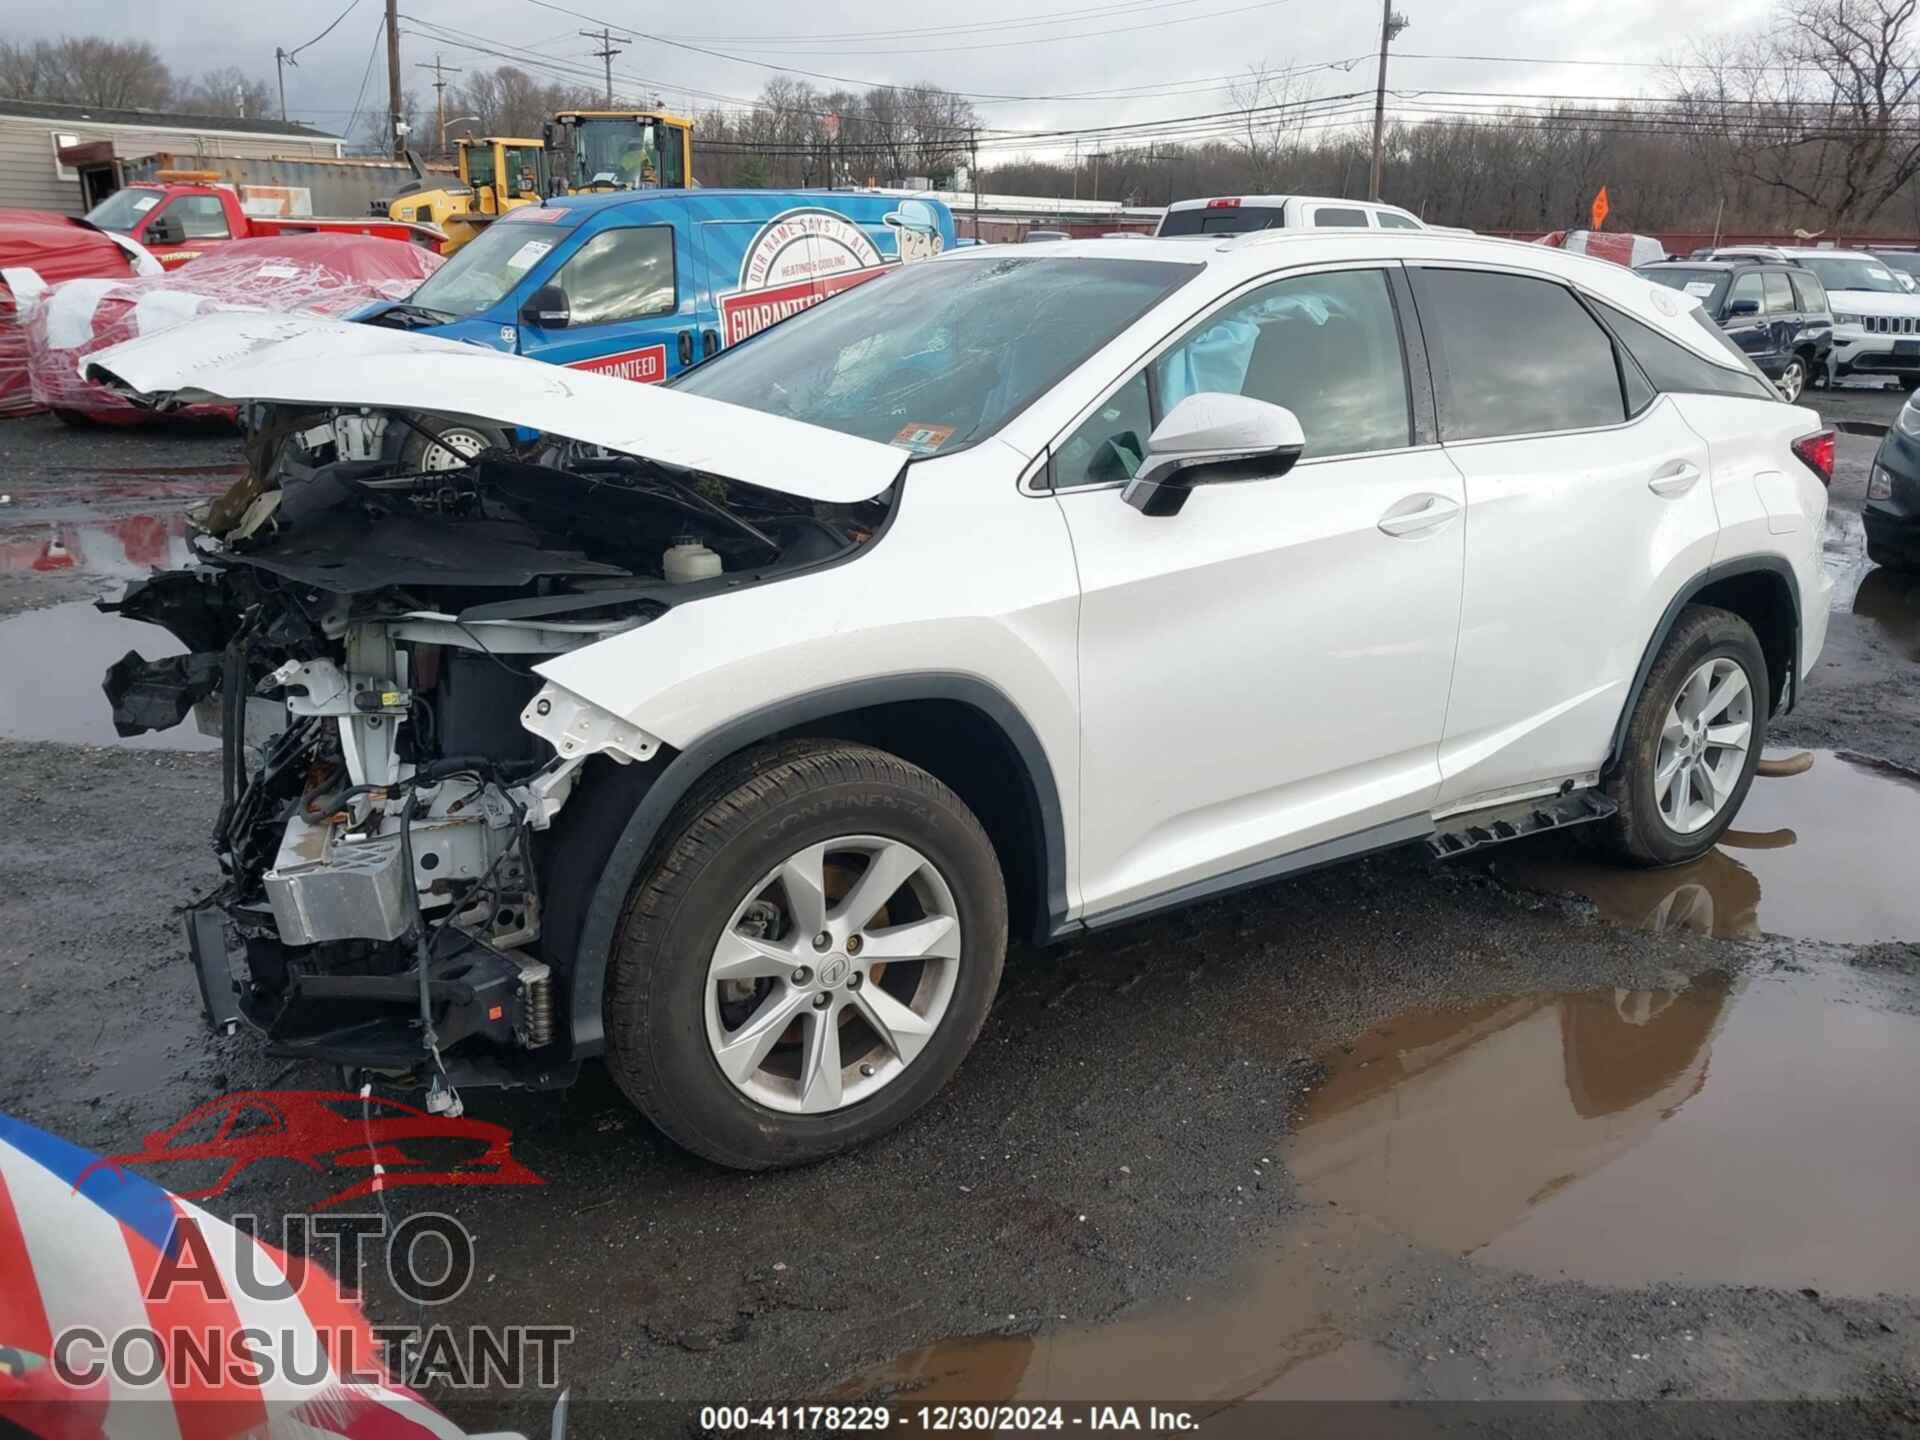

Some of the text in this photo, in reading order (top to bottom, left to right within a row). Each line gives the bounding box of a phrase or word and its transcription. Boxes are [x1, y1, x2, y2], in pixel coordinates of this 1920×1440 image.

[751, 218, 870, 283] OUR NAME SAYS IT ALL
